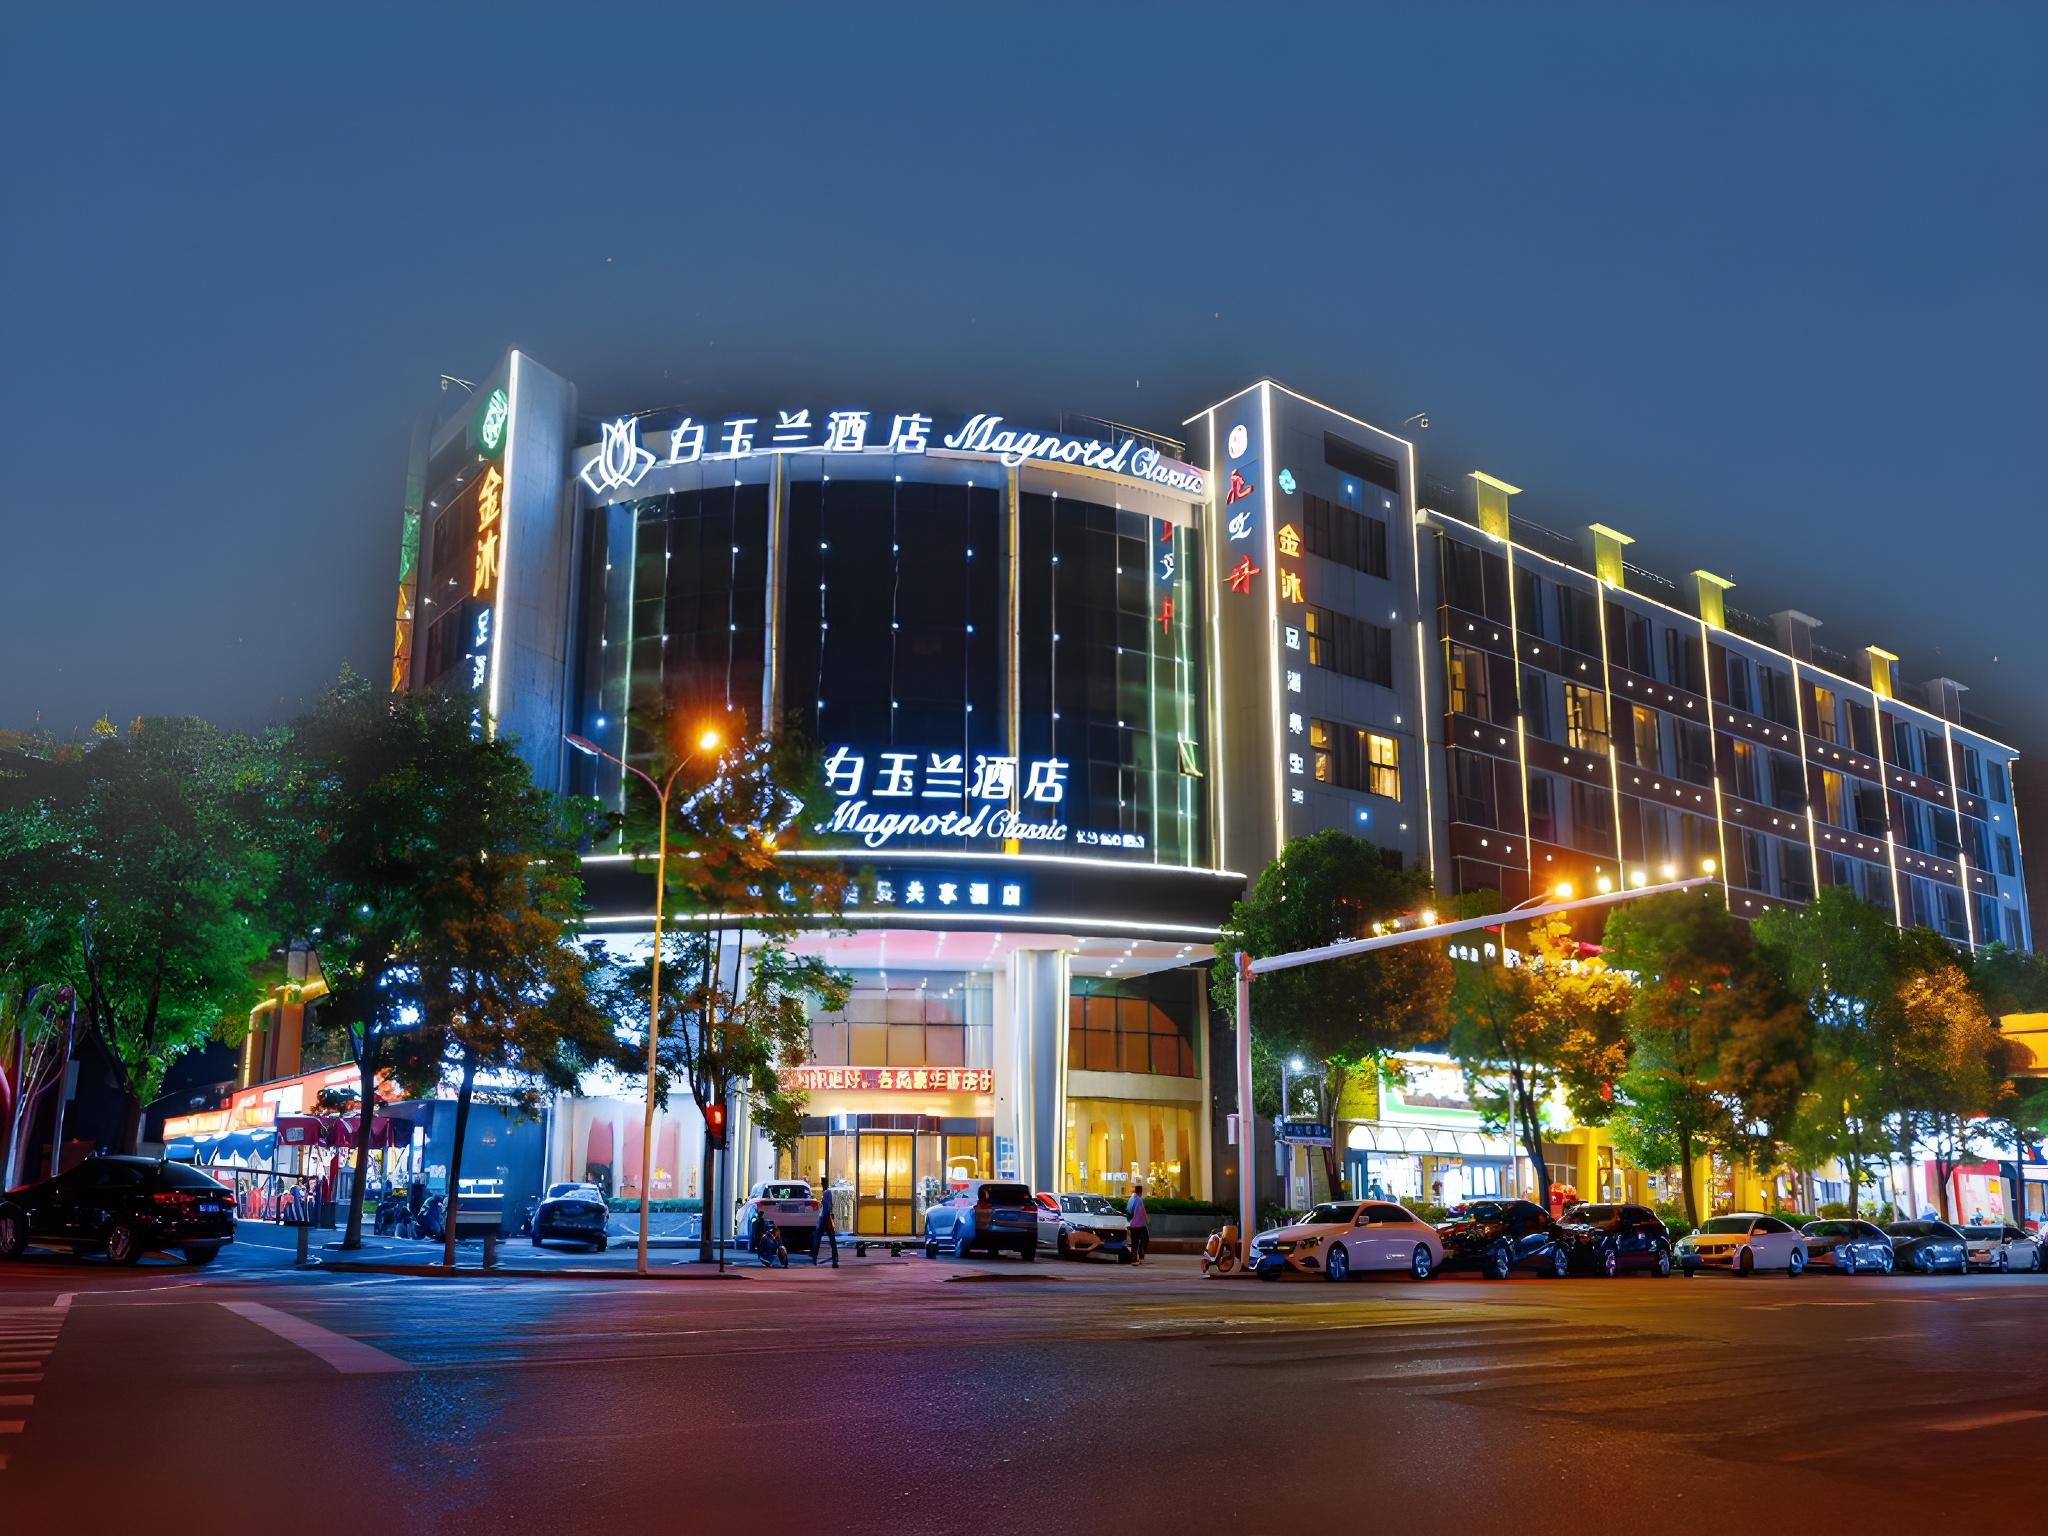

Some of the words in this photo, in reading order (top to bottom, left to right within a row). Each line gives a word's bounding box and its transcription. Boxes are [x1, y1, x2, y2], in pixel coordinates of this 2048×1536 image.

[670, 409, 933, 465] 白玉兰酒店
[944, 413, 1130, 472] Magnotel
[1131, 447, 1205, 494] Classic
[824, 746, 1070, 803] 白玉兰酒店
[816, 800, 991, 847] Magnotel
[986, 809, 1067, 841] Classic
